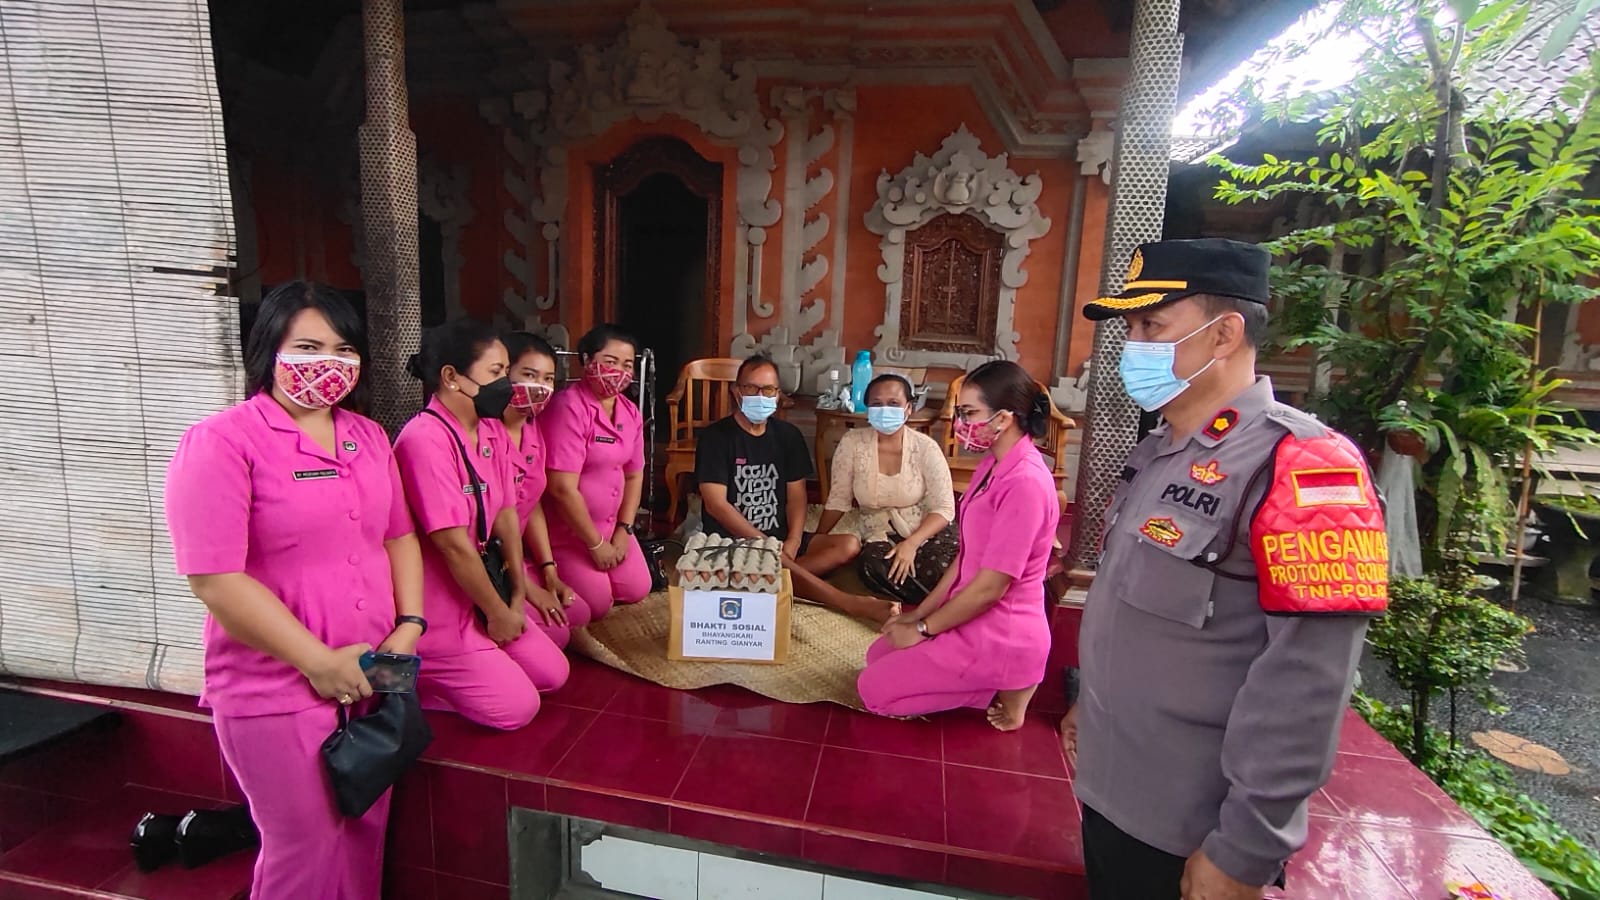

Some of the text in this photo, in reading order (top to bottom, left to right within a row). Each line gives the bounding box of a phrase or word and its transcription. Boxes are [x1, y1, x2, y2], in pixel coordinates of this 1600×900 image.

[1161, 483, 1220, 516] POLRI
[1269, 561, 1352, 585] PROTOKOL
[690, 621, 767, 632] BHAKTI SOSIAL
[702, 631, 753, 639] BHAYANGKARI
[695, 638, 763, 648] RANTING GIANYAR
